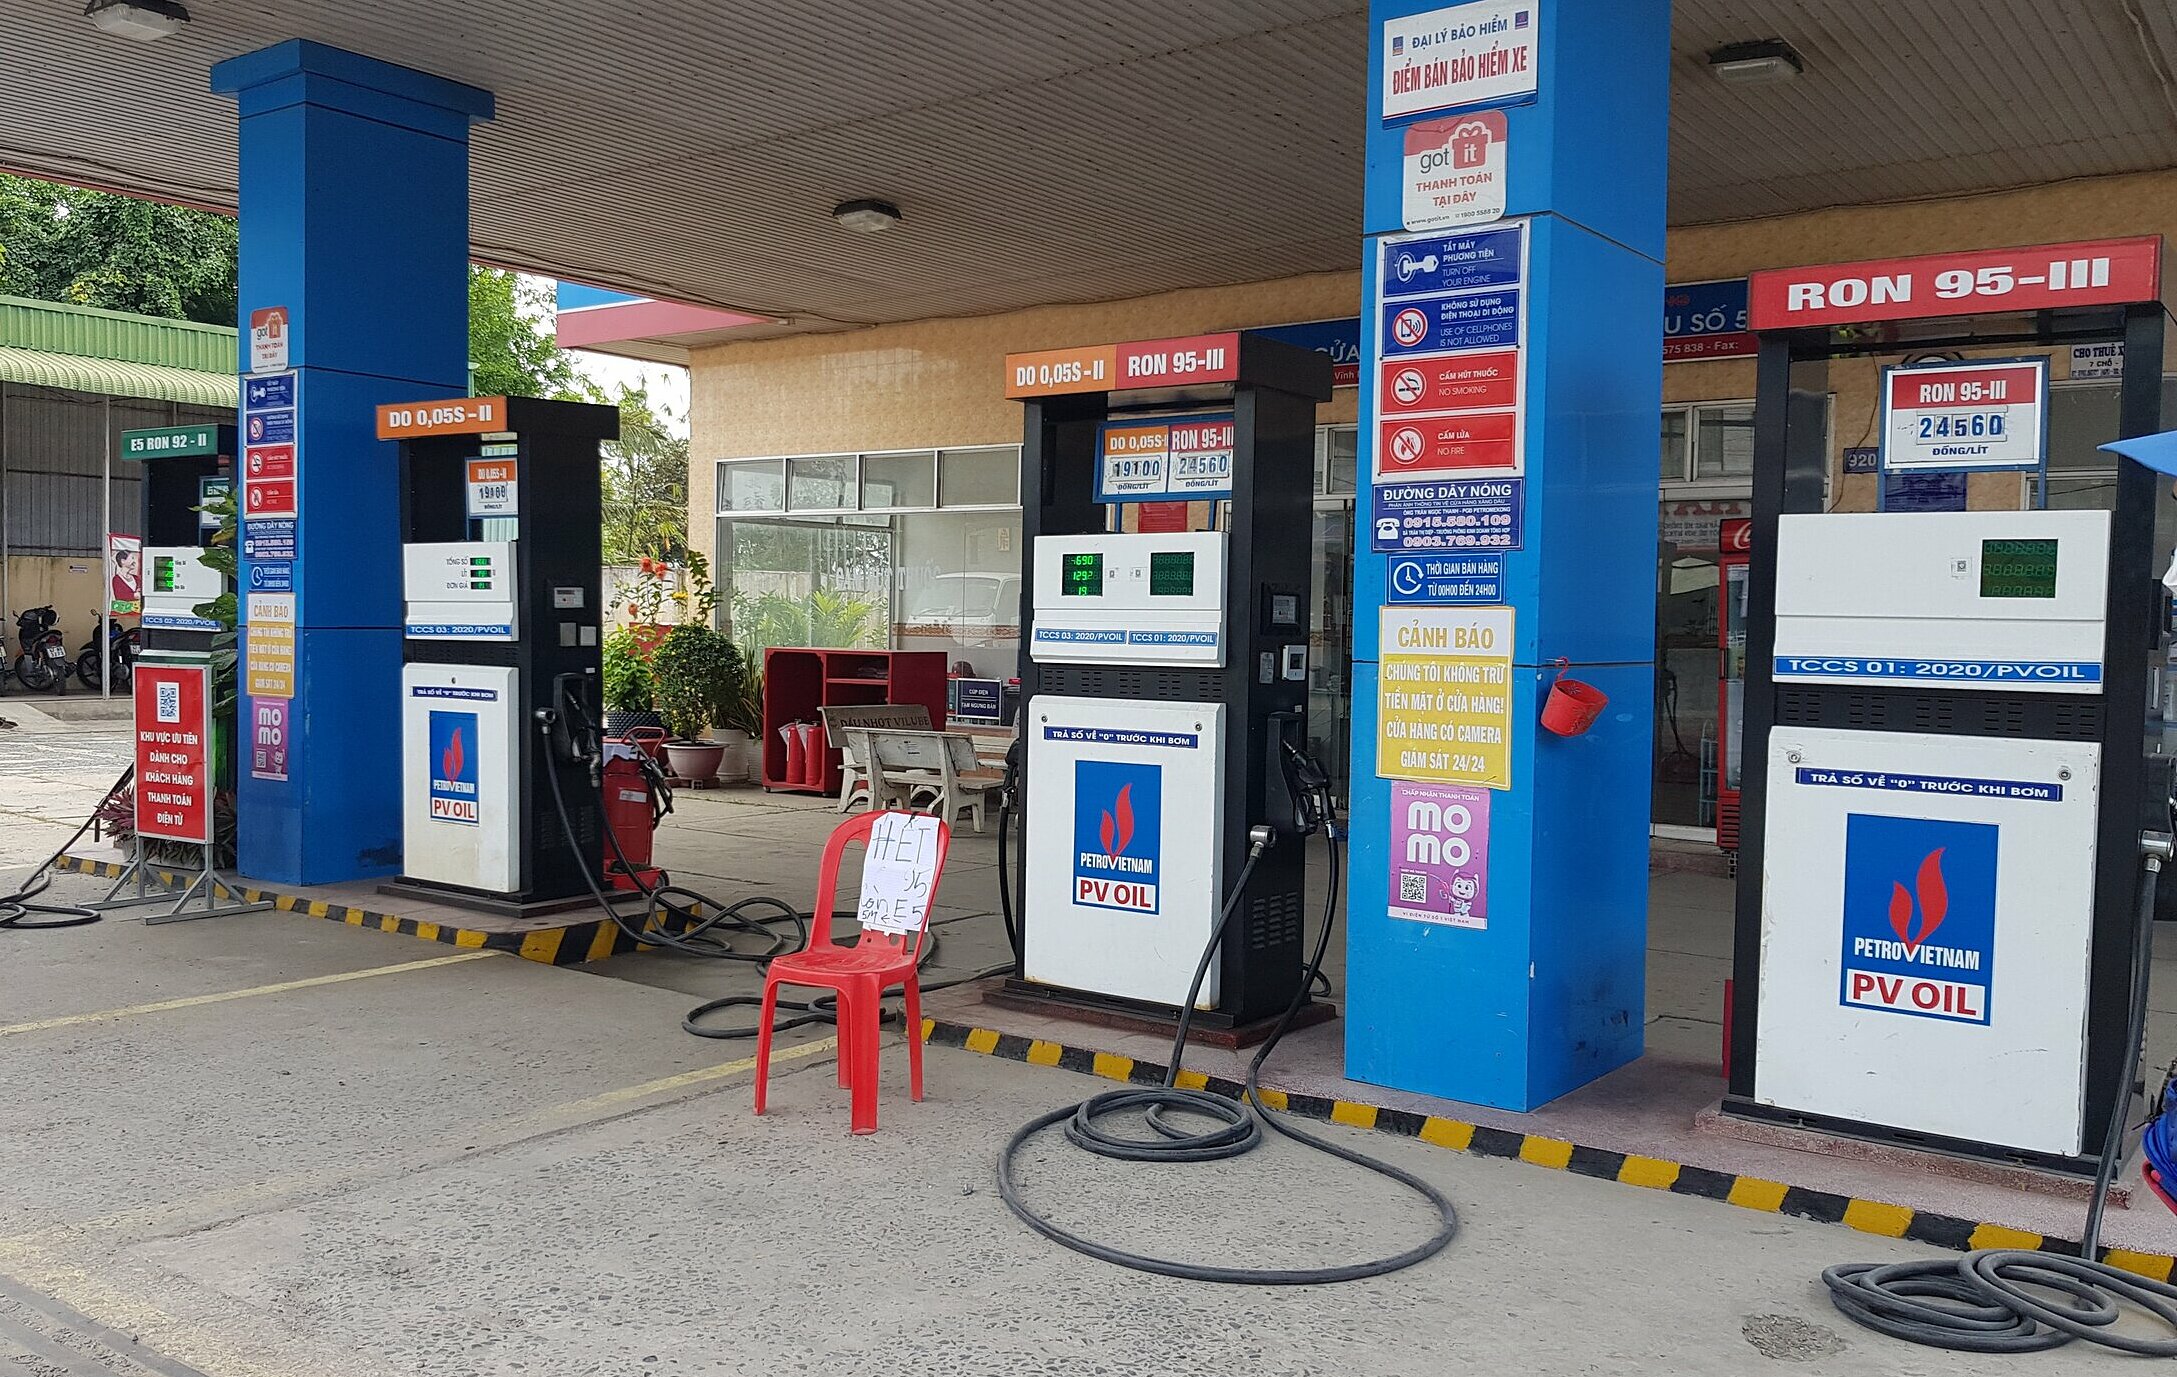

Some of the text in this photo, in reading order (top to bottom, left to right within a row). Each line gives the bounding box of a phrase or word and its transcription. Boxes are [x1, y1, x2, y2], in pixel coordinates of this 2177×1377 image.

[1412, 14, 1508, 49] ĐẠI LÝ BẢO HIỂM
[1393, 41, 1527, 95] ĐIỂM BÁN BẢO HIỂM XE
[1420, 144, 1477, 173] got it
[1416, 173, 1492, 192] THANH TOÁN
[1433, 191, 1476, 208] TẠI ĐÂY
[1443, 241, 1475, 252] TẮT MÁY
[1443, 250, 1494, 262] PHƯƠNG TIỆN
[1442, 266, 1476, 277] TURN OFF
[1442, 275, 1491, 287] YOUR ENGINE
[1788, 258, 2109, 311] RON 95-III
[1441, 301, 1467, 310] KHÔNG
[1481, 298, 1501, 307] DỤNG
[1441, 311, 1457, 320] ĐIỆN
[1459, 310, 1481, 320] THOẠI
[1492, 306, 1514, 315] ĐỘNG
[1690, 304, 1727, 332] SỐ
[1440, 322, 1512, 336] USE OF CELLPHONES
[1440, 335, 1499, 347] IS NOT ALLOWED
[1684, 341, 1738, 352] 838 Fax:
[1128, 348, 1224, 377] RON 95-III
[1017, 367, 1036, 387] DO
[1439, 367, 1498, 380] CẤM HÚT THUỐC
[1439, 386, 1487, 396] NO SMOKING
[1920, 380, 2006, 403] RON 95-III
[389, 411, 411, 427] DO
[1920, 415, 2002, 438] 24560
[131, 438, 144, 451] E5
[147, 437, 169, 450] RON
[172, 435, 187, 448] 92
[1110, 437, 1125, 450] DO
[1172, 426, 1234, 449] RON 95-III
[1438, 431, 1454, 440] CẤM
[1179, 456, 1227, 474] 24560
[1849, 453, 1876, 467] 920
[1114, 461, 1160, 477] 19100
[1383, 483, 1511, 500] ĐƯỜNG DÂY NÓNG
[1403, 515, 1511, 528] 0915.580.109
[1403, 535, 1510, 547] 0903.769.932
[1426, 559, 1498, 575] THỜI GIAN BÁN HÀNG
[1428, 579, 1496, 596] TỪ 00H00 ĐẾN 24H00
[452, 626, 506, 634] 2020/PVOIL
[1039, 631, 1059, 639] TCCS
[1076, 632, 1122, 641] 2020/PVOIL
[1398, 619, 1493, 648] CẢNH BÁO
[1132, 634, 1152, 642] TCCS
[1168, 634, 1213, 643] 2020/PVOIL
[1387, 661, 1479, 683] CHÚNG TÔI KHÔNG
[1789, 659, 2085, 678] TCCS 01: 2020/PVOIL
[1385, 686, 1504, 715] TIỀN MẶT Ở CỬA HÀNG!
[894, 716, 929, 726] VILUBE
[1053, 730, 1069, 738] TRẢ
[1072, 730, 1083, 739] SỐ
[1086, 730, 1097, 740] VỀ
[1116, 734, 1147, 743] TRƯỚC
[1168, 736, 1189, 745] BƠM
[1387, 716, 1501, 743] CỬA HÀNG CÓ CAMERA
[141, 732, 154, 741] KHU
[156, 733, 170, 745] VỰC
[183, 732, 197, 744] TIÊN
[150, 751, 187, 765] DÀNH CHO
[1401, 748, 1485, 772] GIÁM SÁT 24/24
[146, 771, 193, 785] KHÁCH HÀNG
[1810, 772, 2049, 798] TRẢ SỐ VỀ TRƯỚC KHI BƠM
[148, 792, 191, 806] THANH TOÁN
[435, 800, 474, 818] PV OIL
[157, 812, 173, 827] ĐIỆN
[1081, 853, 1152, 874] PETROVIETNAM
[1080, 880, 1151, 908] PV OIL
[1854, 937, 1980, 970] PETROVIETNAM
[1852, 972, 1977, 1016] PV OIL
